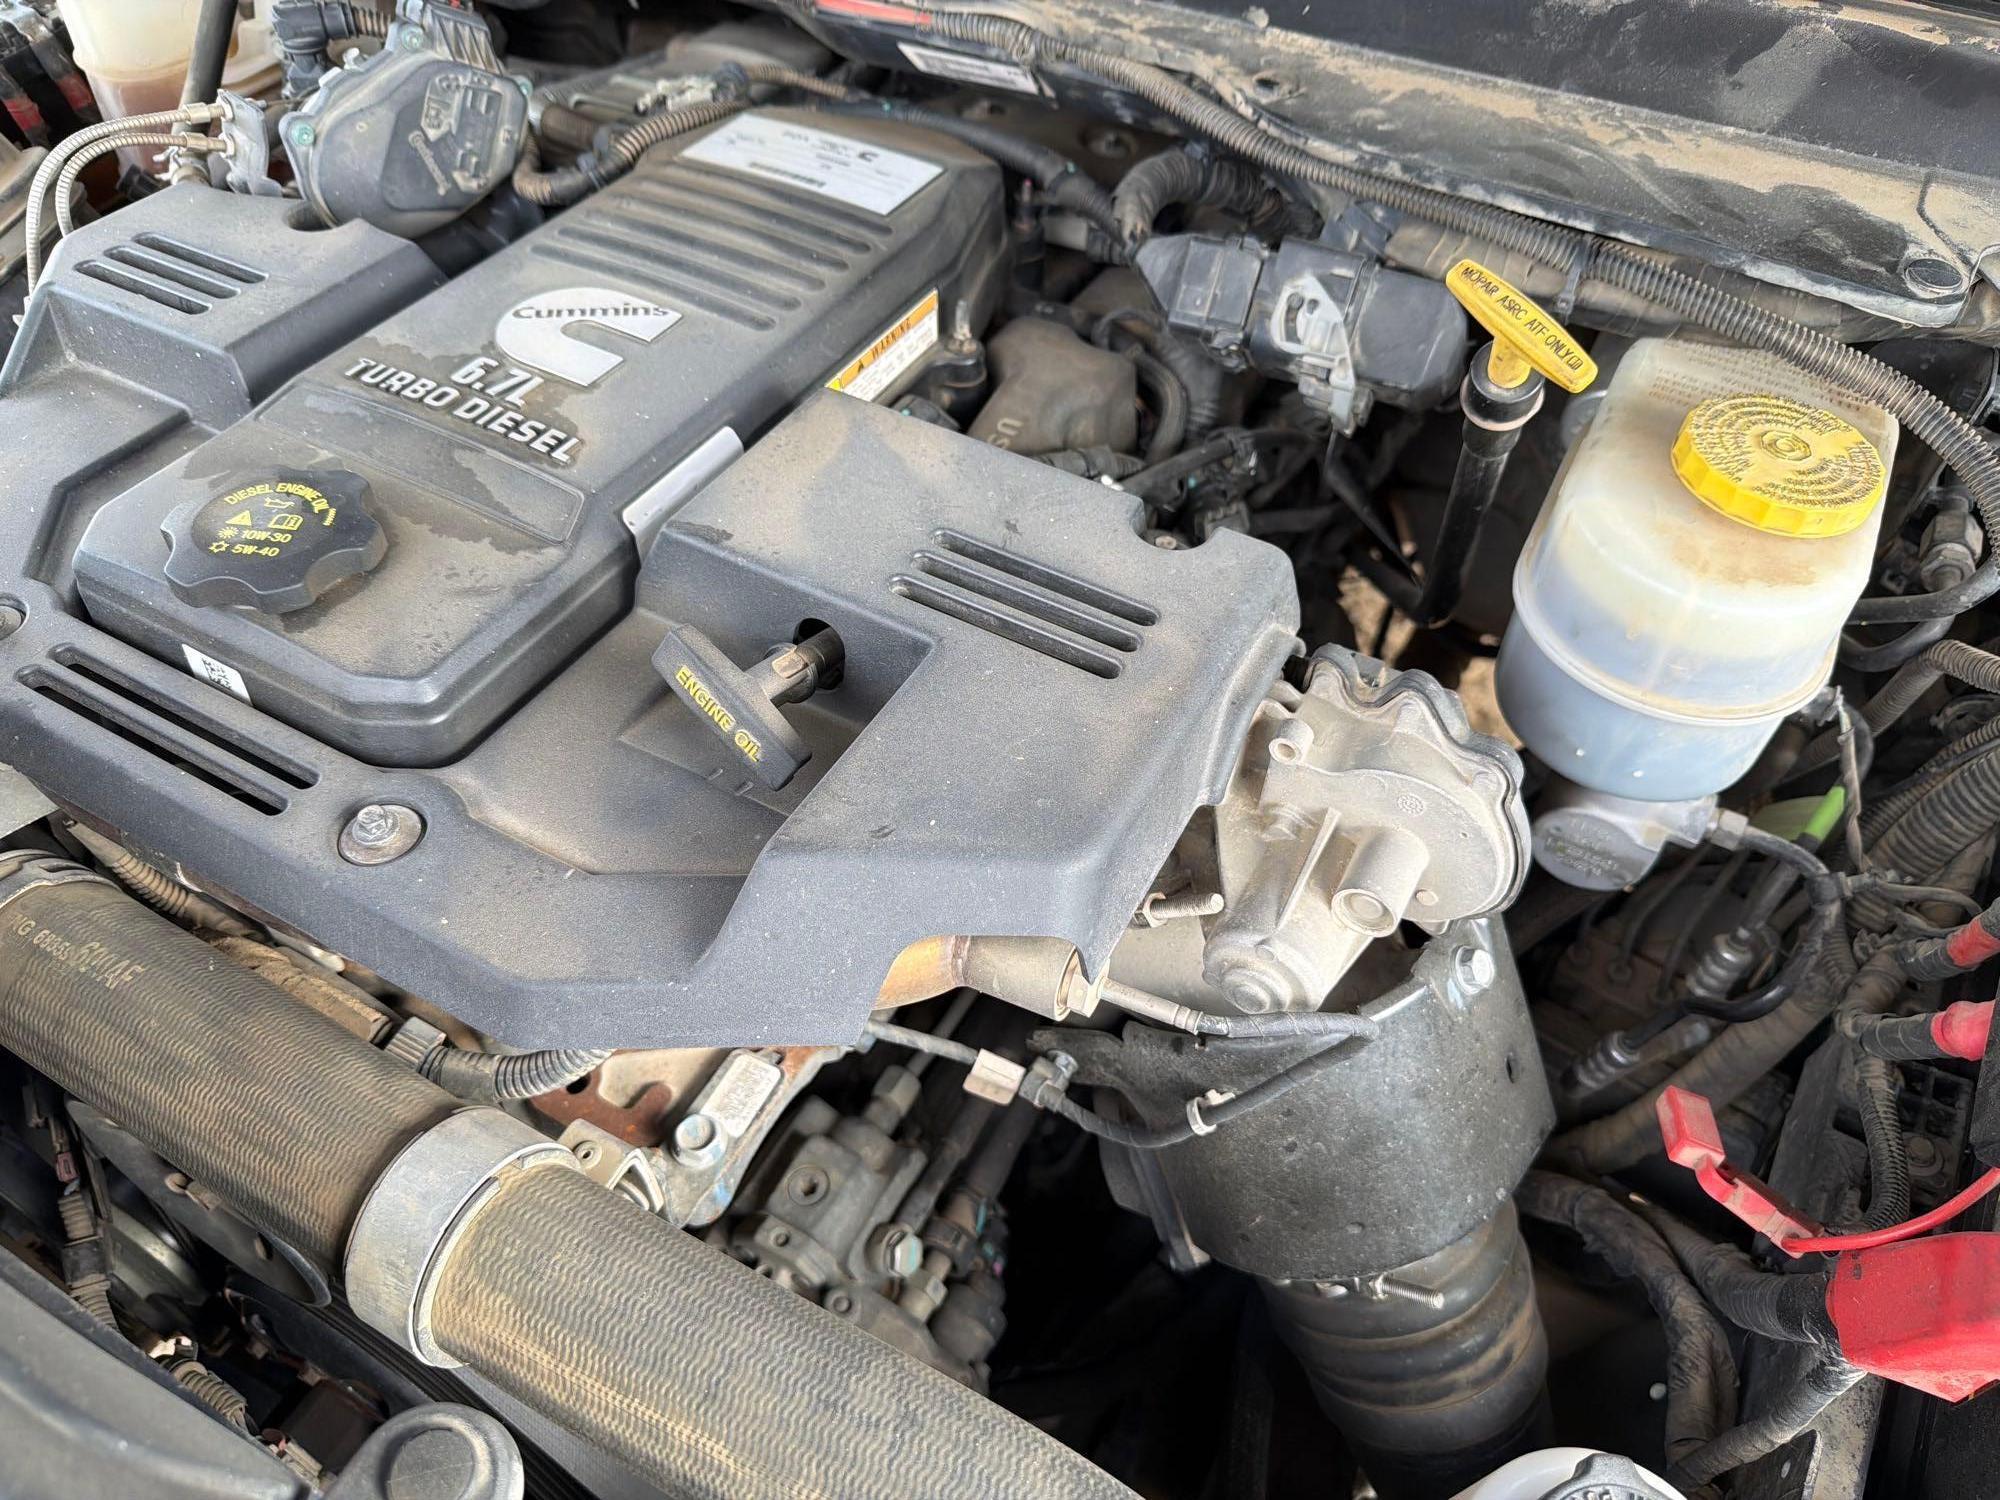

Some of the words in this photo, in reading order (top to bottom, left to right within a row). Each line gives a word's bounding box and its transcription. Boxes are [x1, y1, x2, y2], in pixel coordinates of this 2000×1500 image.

[511, 303, 669, 319] Cummins
[1462, 267, 1500, 297] MOPAR
[1496, 295, 1528, 321] ASRC
[1524, 318, 1550, 338] ATF
[1544, 334, 1574, 361] ONLY
[450, 356, 545, 409] 6.7L
[344, 357, 461, 407] TURBO
[453, 397, 582, 463] DIESEL
[224, 484, 273, 505] DIESEL
[275, 482, 322, 501] ENGINE
[311, 498, 329, 514] OIL
[231, 543, 280, 557] 5W-40
[241, 529, 293, 543] 10W-30
[675, 665, 736, 733] ENGINE
[734, 729, 761, 762] OIL
